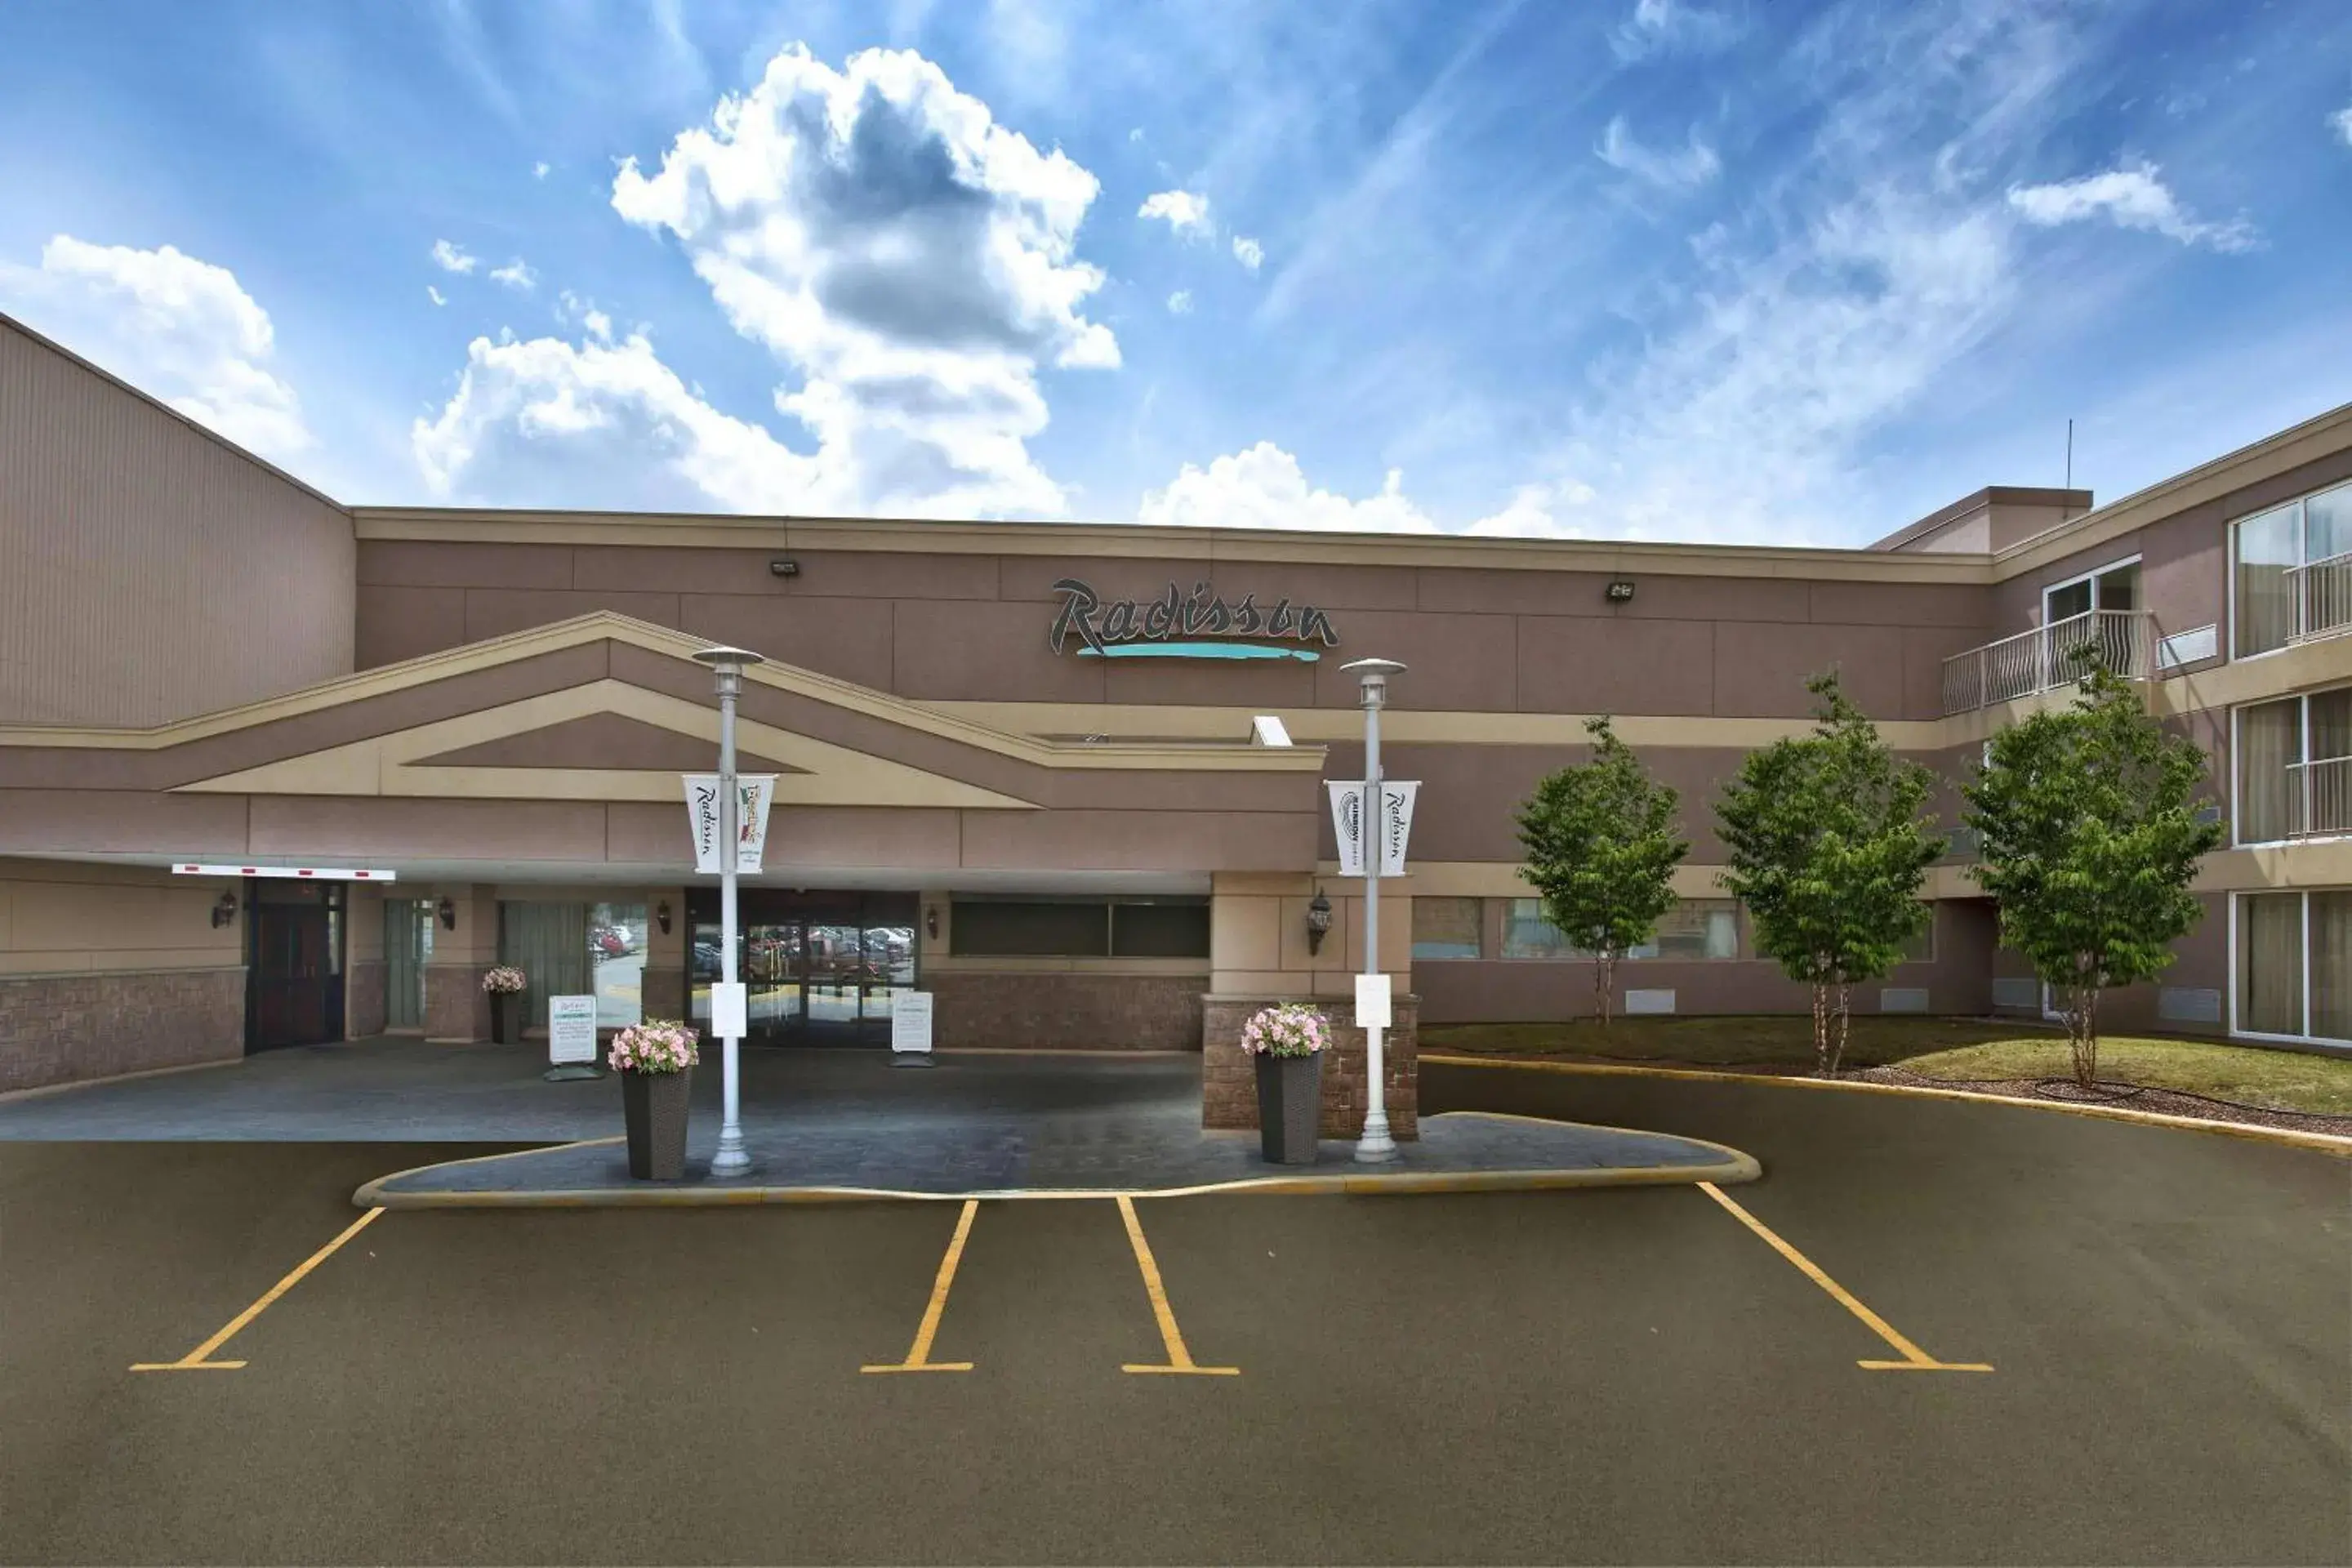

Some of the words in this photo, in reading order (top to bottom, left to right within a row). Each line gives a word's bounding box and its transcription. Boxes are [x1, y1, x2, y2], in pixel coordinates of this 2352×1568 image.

[1050, 578, 1339, 654] Radisson
[696, 786, 717, 855] Radisson
[1386, 792, 1405, 858] Radisson
